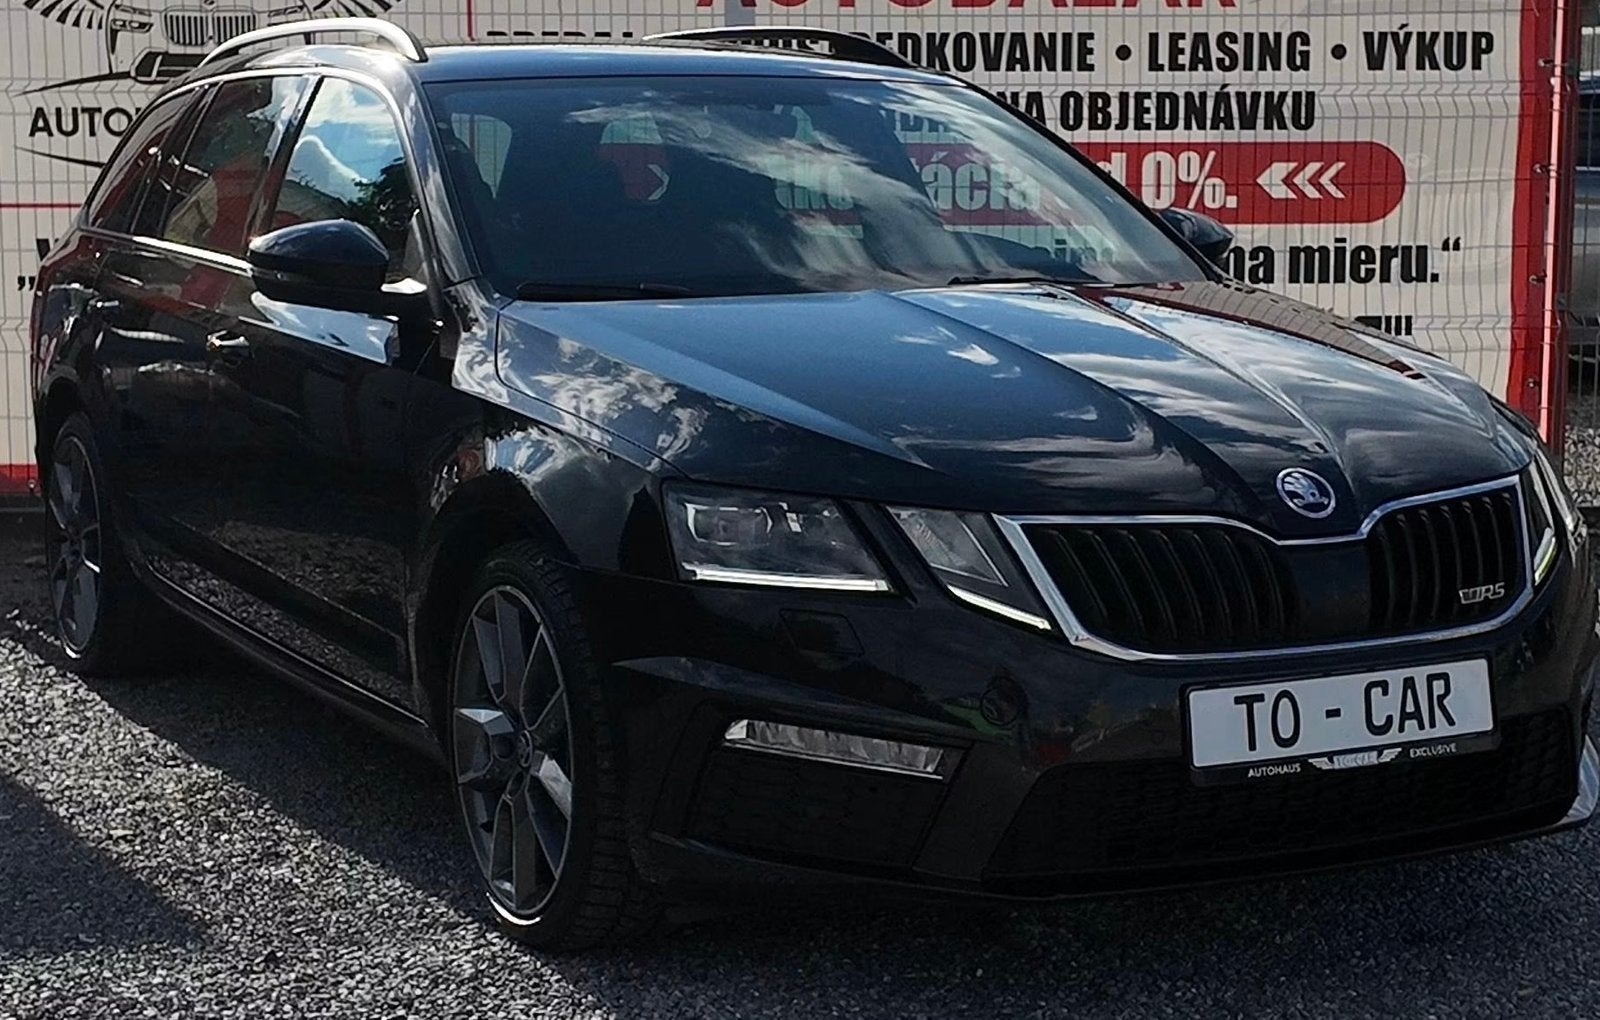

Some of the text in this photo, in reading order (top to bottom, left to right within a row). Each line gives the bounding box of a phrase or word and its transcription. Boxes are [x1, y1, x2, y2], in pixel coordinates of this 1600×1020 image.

[1148, 31, 1312, 73] LEASING
[1363, 23, 1495, 72] VÝKUP
[29, 107, 142, 137] AUTO
[1060, 83, 1316, 131] OBJEDNÁVKU
[1233, 689, 1301, 752] TO
[1363, 671, 1457, 737] CAR
[1248, 763, 1301, 778] AUTOHAUS
